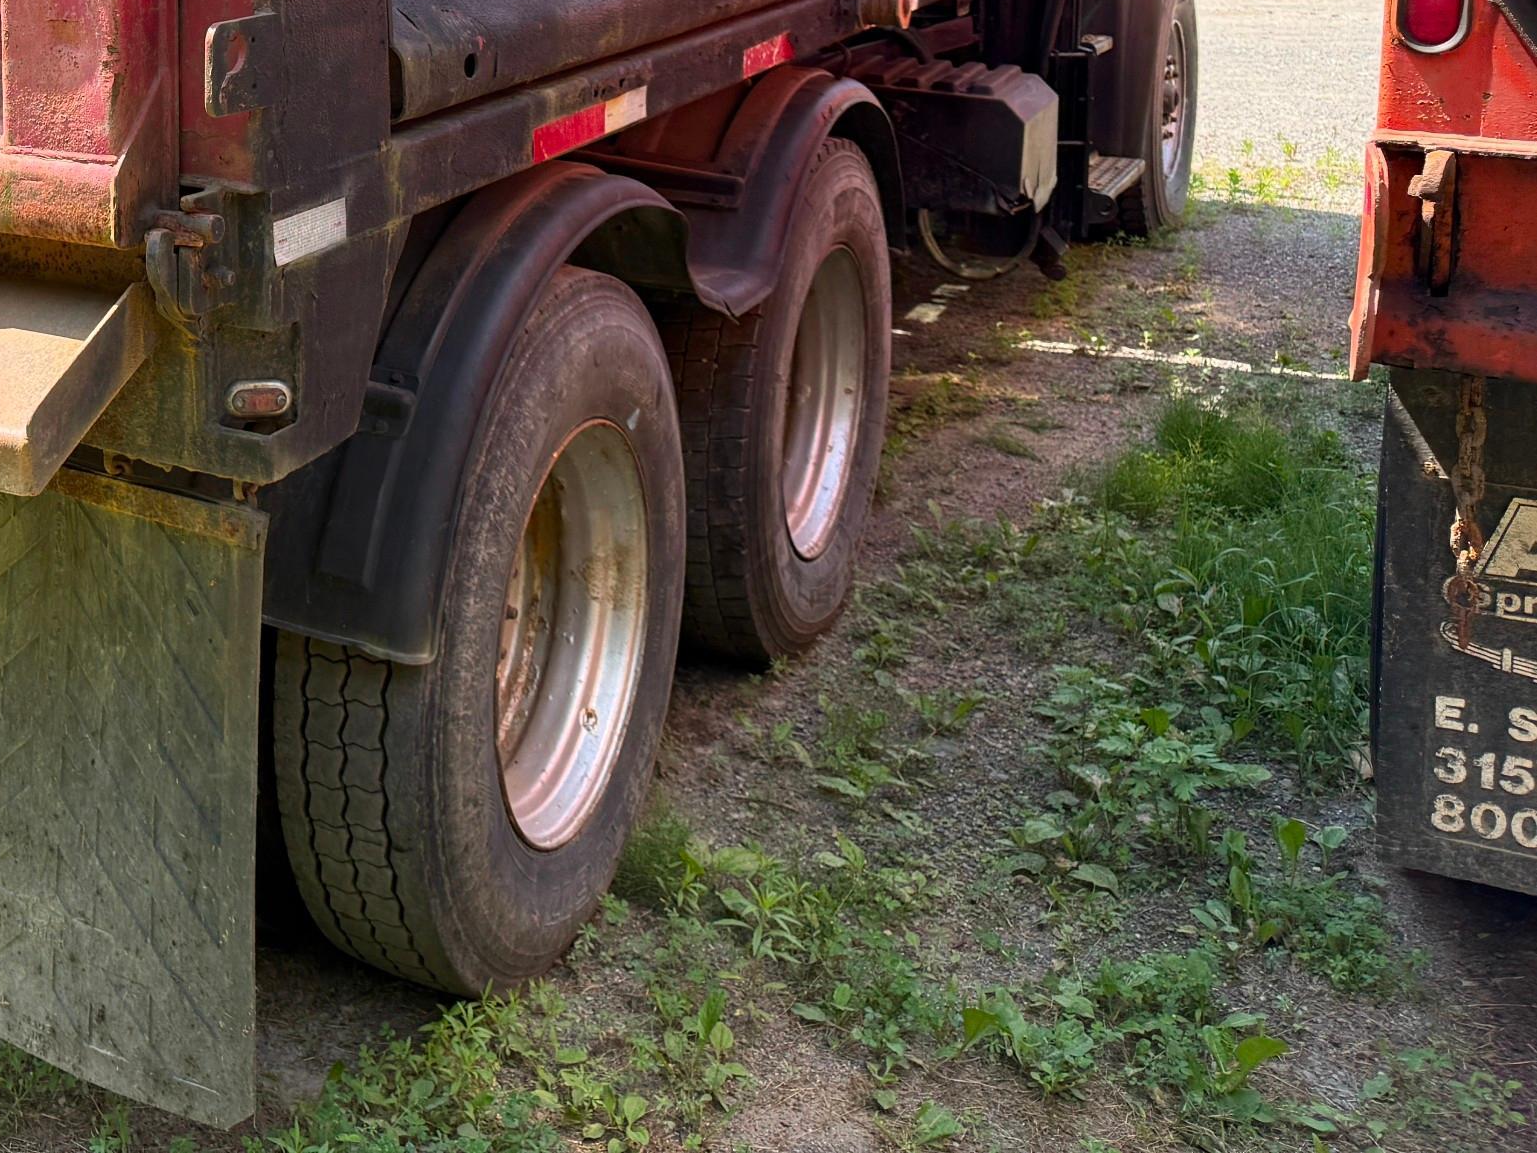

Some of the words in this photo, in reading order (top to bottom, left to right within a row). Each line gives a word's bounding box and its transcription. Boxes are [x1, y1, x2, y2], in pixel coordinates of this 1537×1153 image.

[1435, 695, 1479, 734] E.
[1433, 746, 1536, 796] 315
[1431, 794, 1537, 848] 800
